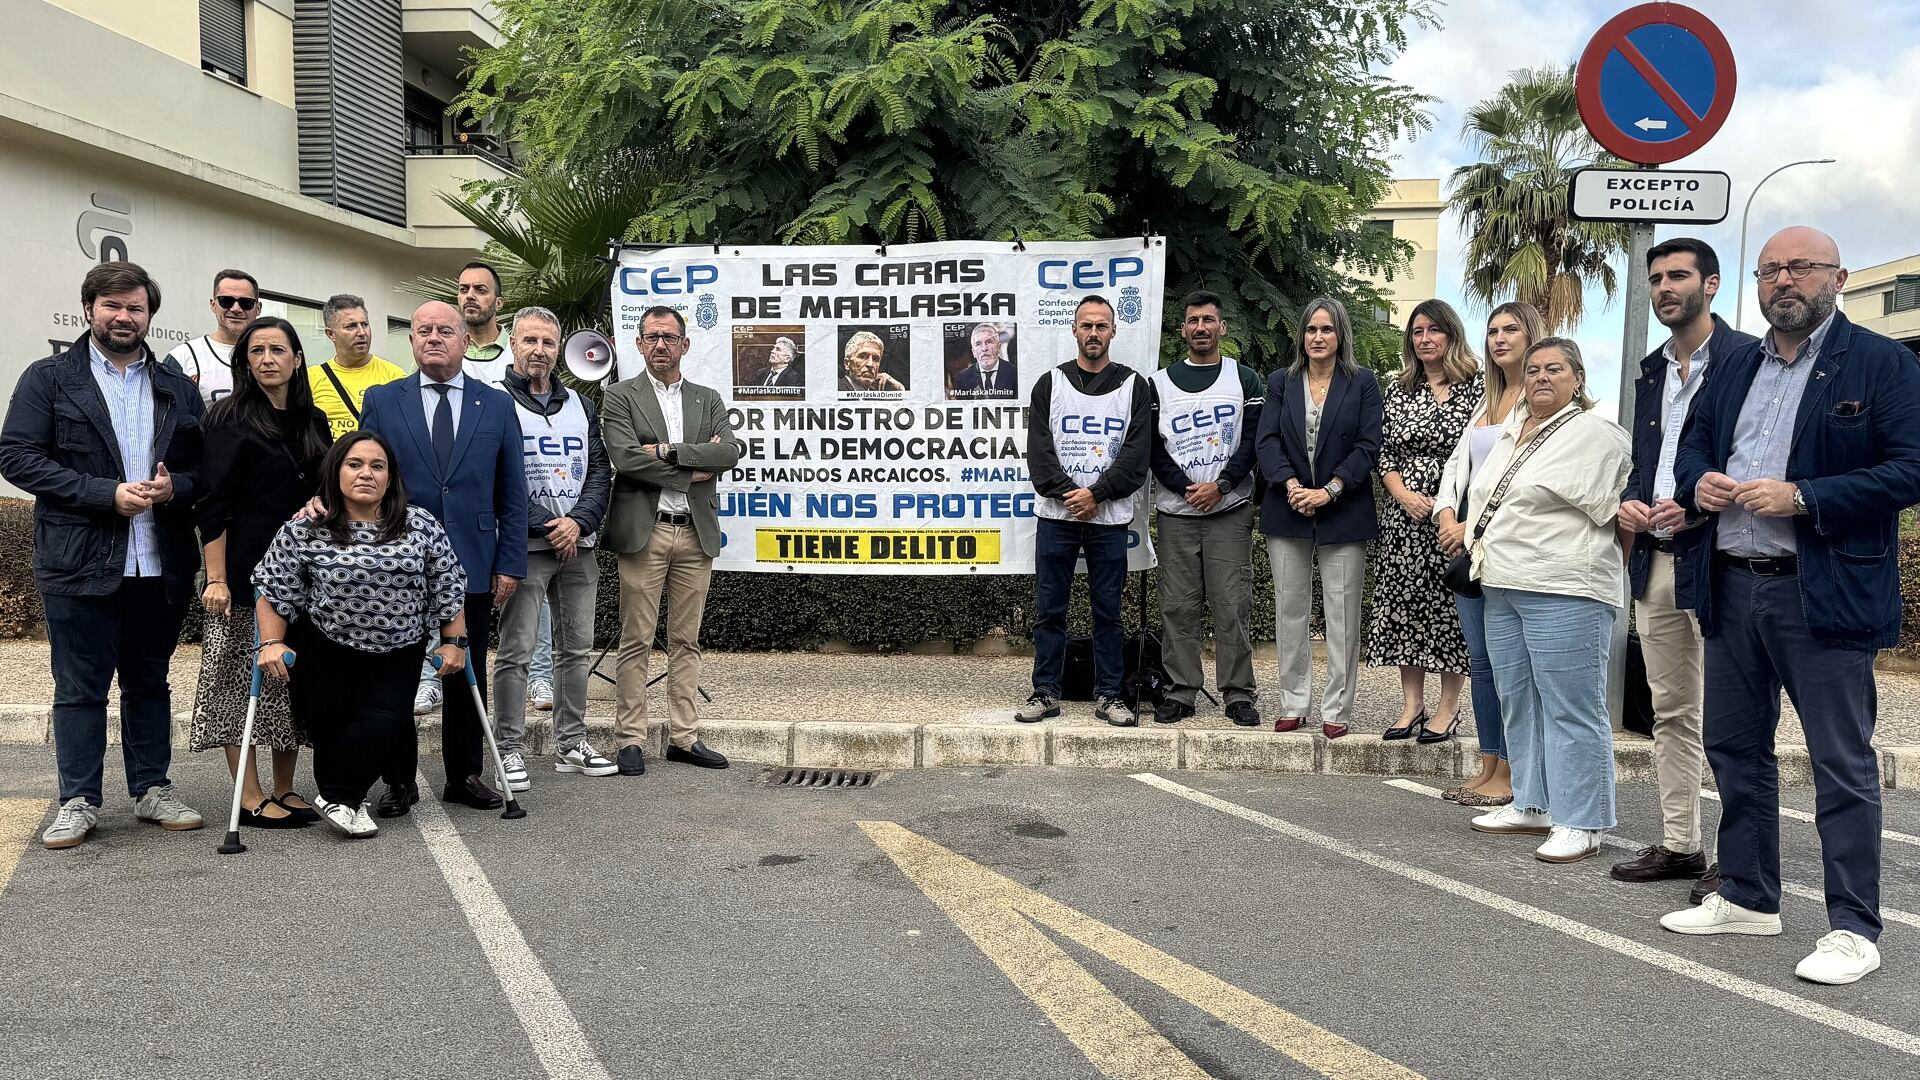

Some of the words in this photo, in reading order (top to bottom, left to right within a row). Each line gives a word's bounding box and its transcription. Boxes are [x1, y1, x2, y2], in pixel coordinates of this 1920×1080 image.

[1607, 178, 1699, 191] EXCEPTO
[1609, 197, 1694, 211] POLICÍA
[620, 265, 718, 295] CEP
[762, 263, 838, 286] LAS
[855, 259, 985, 286] CARAS
[1038, 257, 1144, 289] CEP
[731, 296, 781, 319] DE
[800, 292, 1016, 319] MARLASKA
[738, 387, 801, 395] #MarlaskaDimite
[950, 388, 1013, 396] #MarlaskaDimite
[774, 408, 915, 430] MINISTRO
[924, 407, 963, 430] DE
[1062, 415, 1124, 435] CEP
[1171, 405, 1235, 433] CEP
[523, 436, 583, 456] CEP
[774, 438, 811, 460] LA
[820, 436, 1027, 460] DEMOCRACIA.
[731, 468, 756, 482] DE
[761, 468, 841, 482] MANDOS
[847, 468, 950, 482] ARCAICOS.
[716, 487, 791, 517] UIÉN
[806, 493, 877, 518] NOS
[893, 493, 1035, 518] PROTEG
[776, 535, 859, 559] TIENE
[871, 536, 976, 559] DELITO
